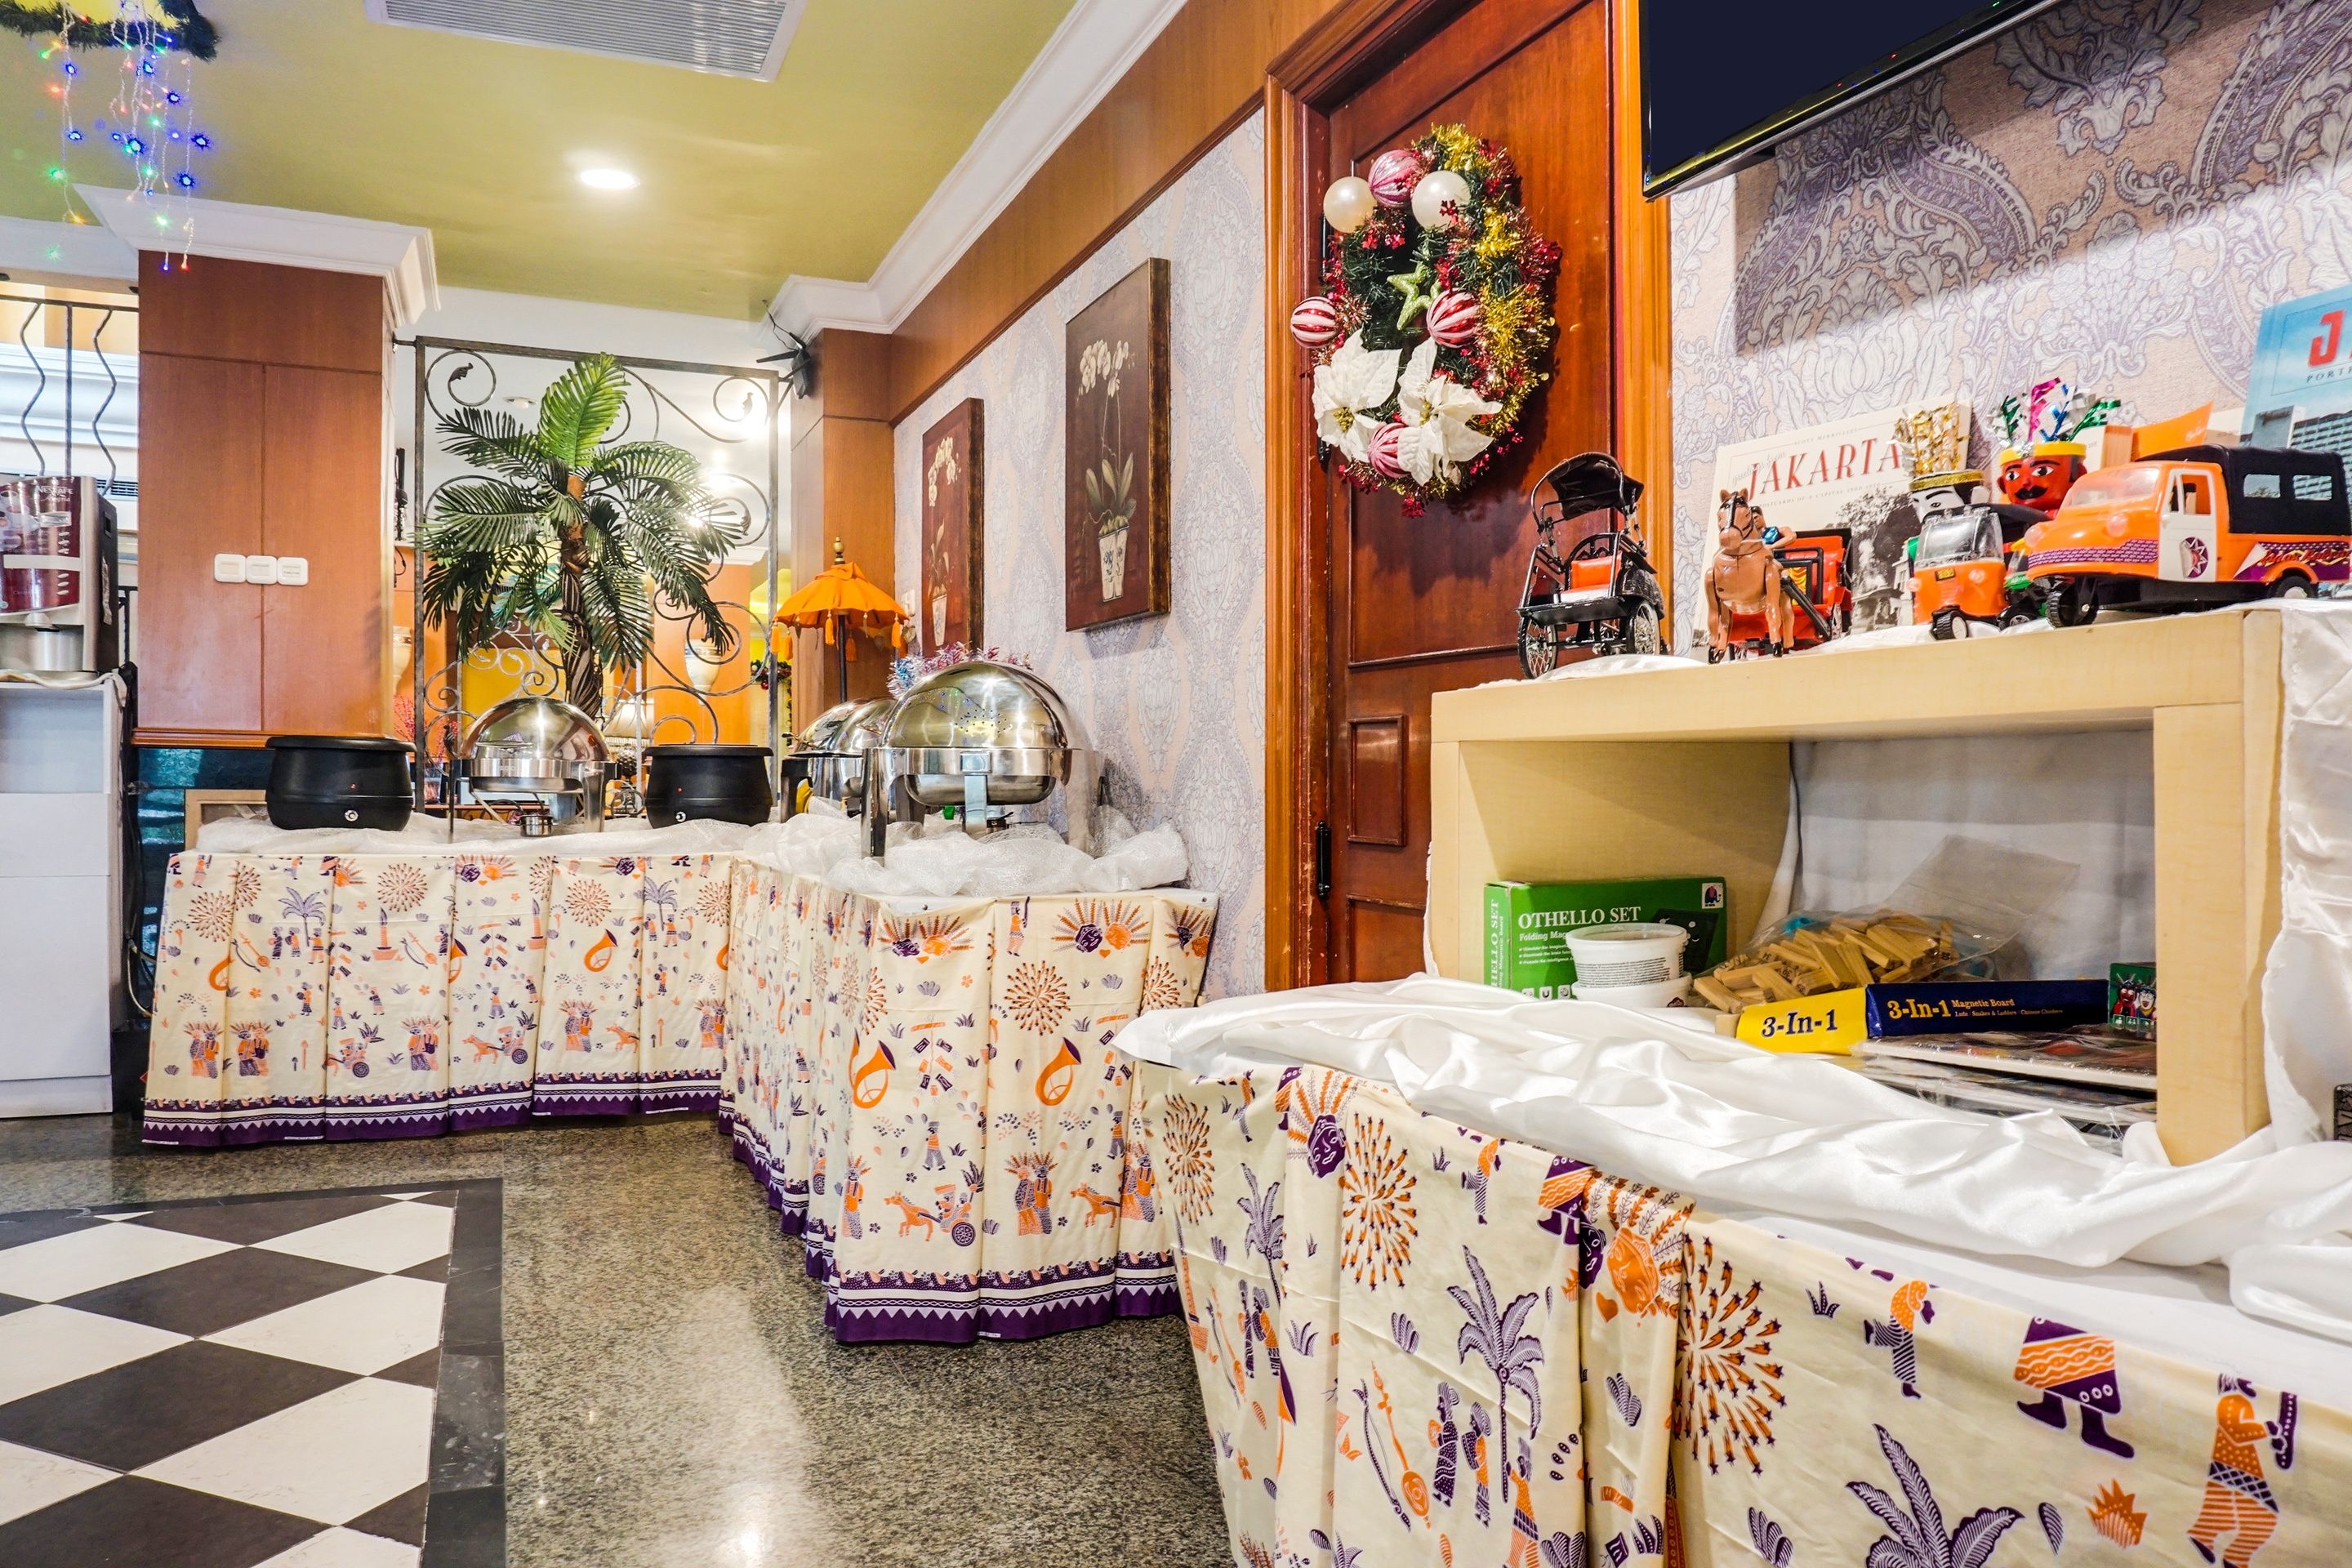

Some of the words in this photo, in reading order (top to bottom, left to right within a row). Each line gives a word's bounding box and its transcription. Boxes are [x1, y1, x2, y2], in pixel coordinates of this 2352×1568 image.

[2309, 310, 2352, 368] J
[1748, 437, 1903, 501] JAKARTA
[1490, 899, 1499, 929] SET
[1518, 908, 1606, 929] OTHELLO
[1610, 906, 1642, 923] SET
[1519, 932, 1548, 942] Folding
[1762, 1009, 1838, 1037] 3-In-1
[1886, 998, 1952, 1020] 3-In-1
[1951, 1000, 1989, 1009] Magnetic
[1990, 999, 2016, 1008] Board
